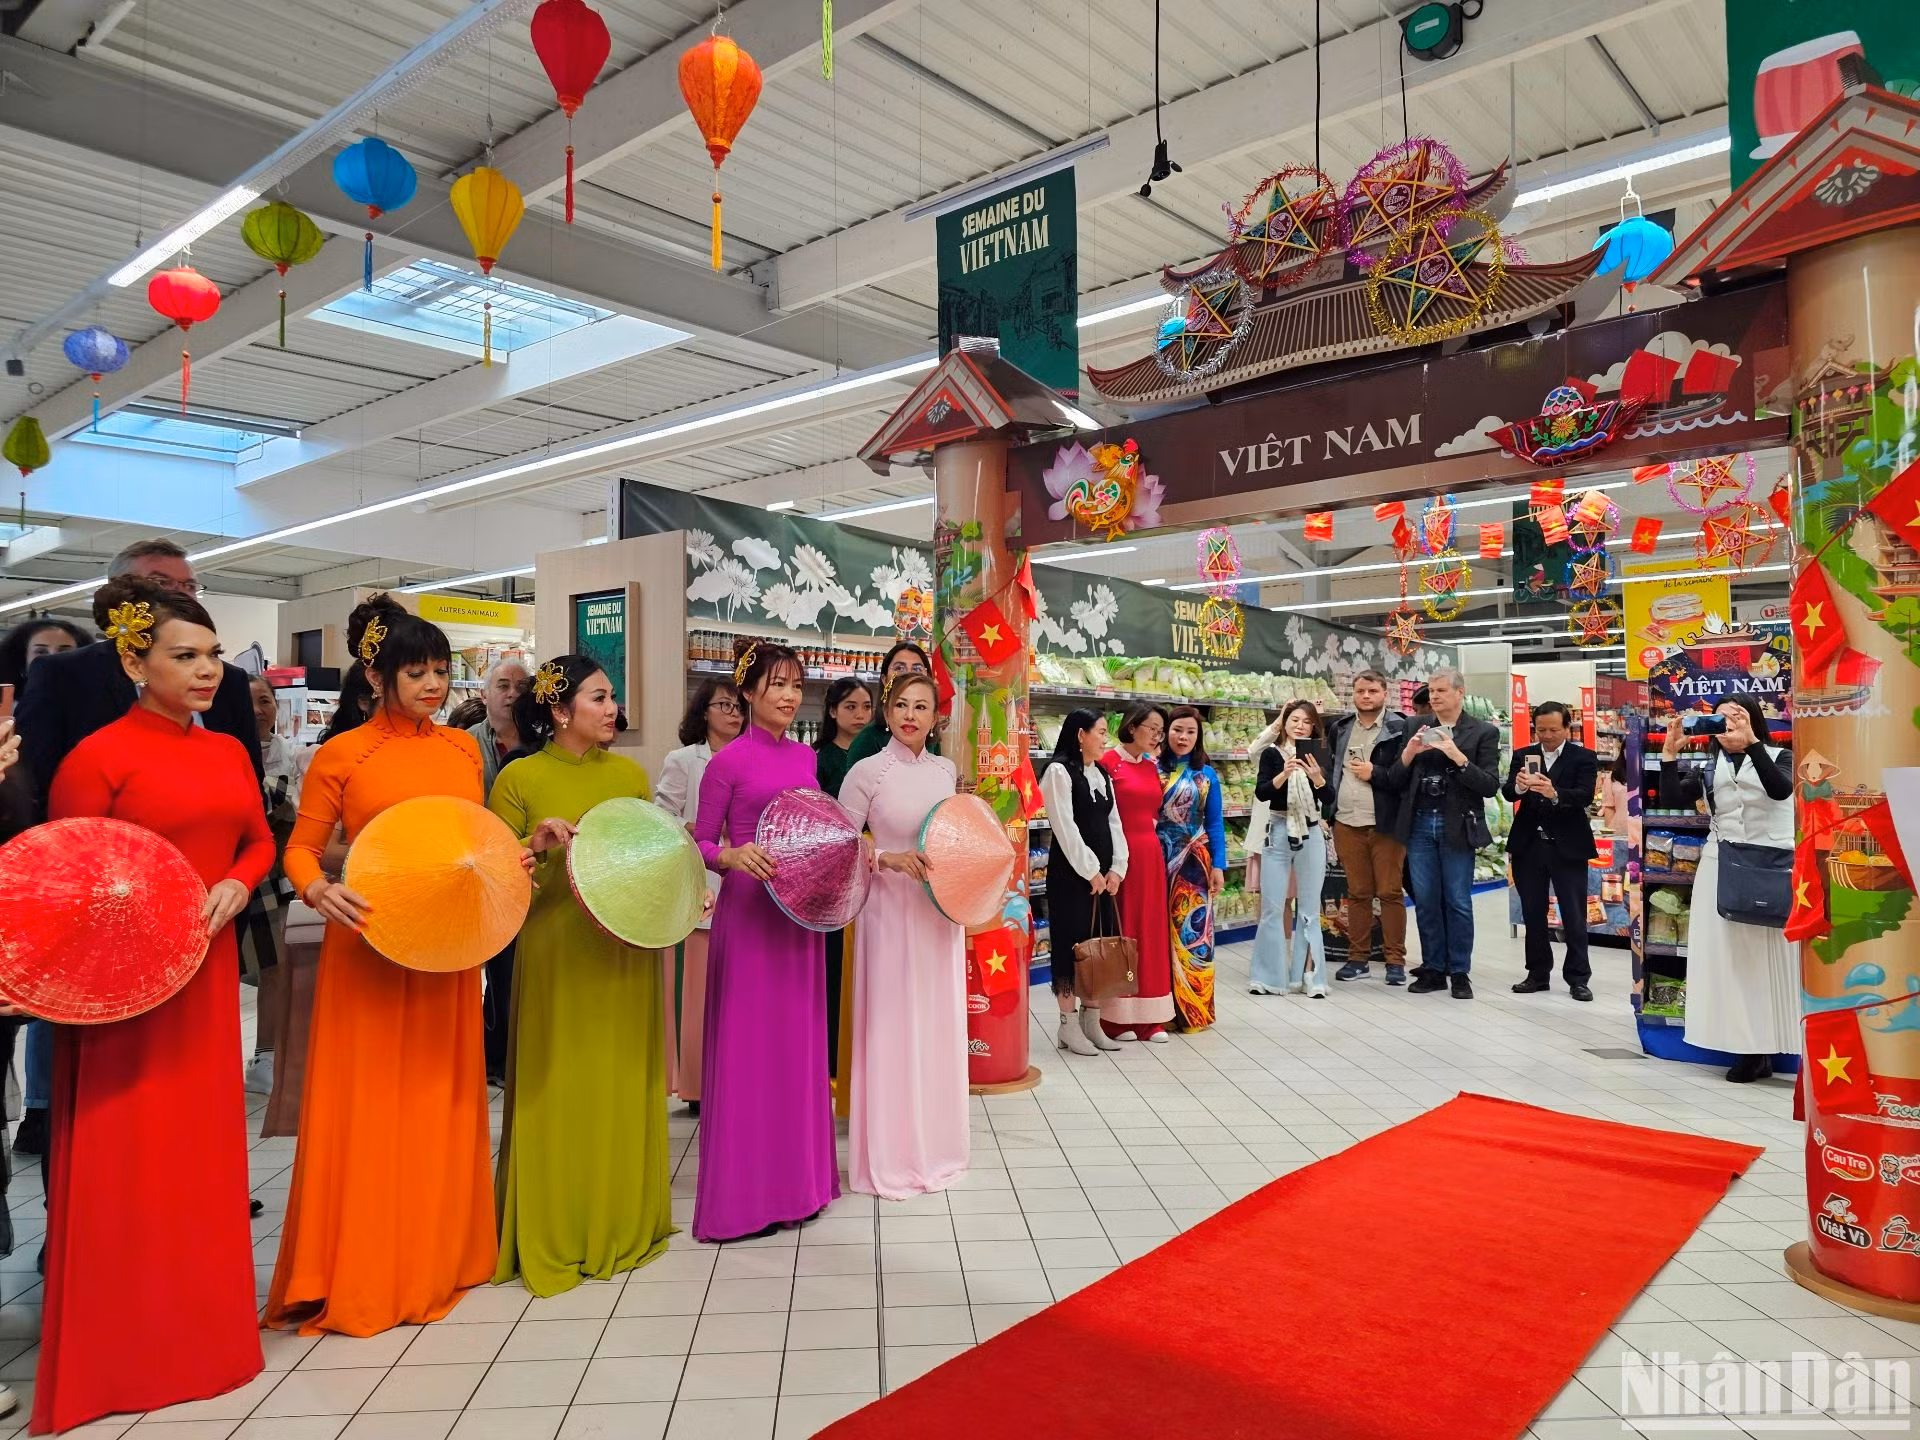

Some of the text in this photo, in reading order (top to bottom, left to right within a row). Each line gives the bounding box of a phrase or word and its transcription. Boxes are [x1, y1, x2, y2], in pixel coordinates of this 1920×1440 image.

[962, 187, 1045, 238] SEMAINE DU
[960, 214, 1049, 274] VIETNAM
[1219, 413, 1423, 477] VIÊT NAM
[438, 606, 499, 618] AUTRES ANIMAUX
[587, 602, 622, 616] SEMAINE DU
[586, 616, 623, 635] VIETNAM
[1669, 675, 1727, 697] VIÊT
[1732, 676, 1786, 694] NAM
[1848, 1228, 1865, 1246] Vi
